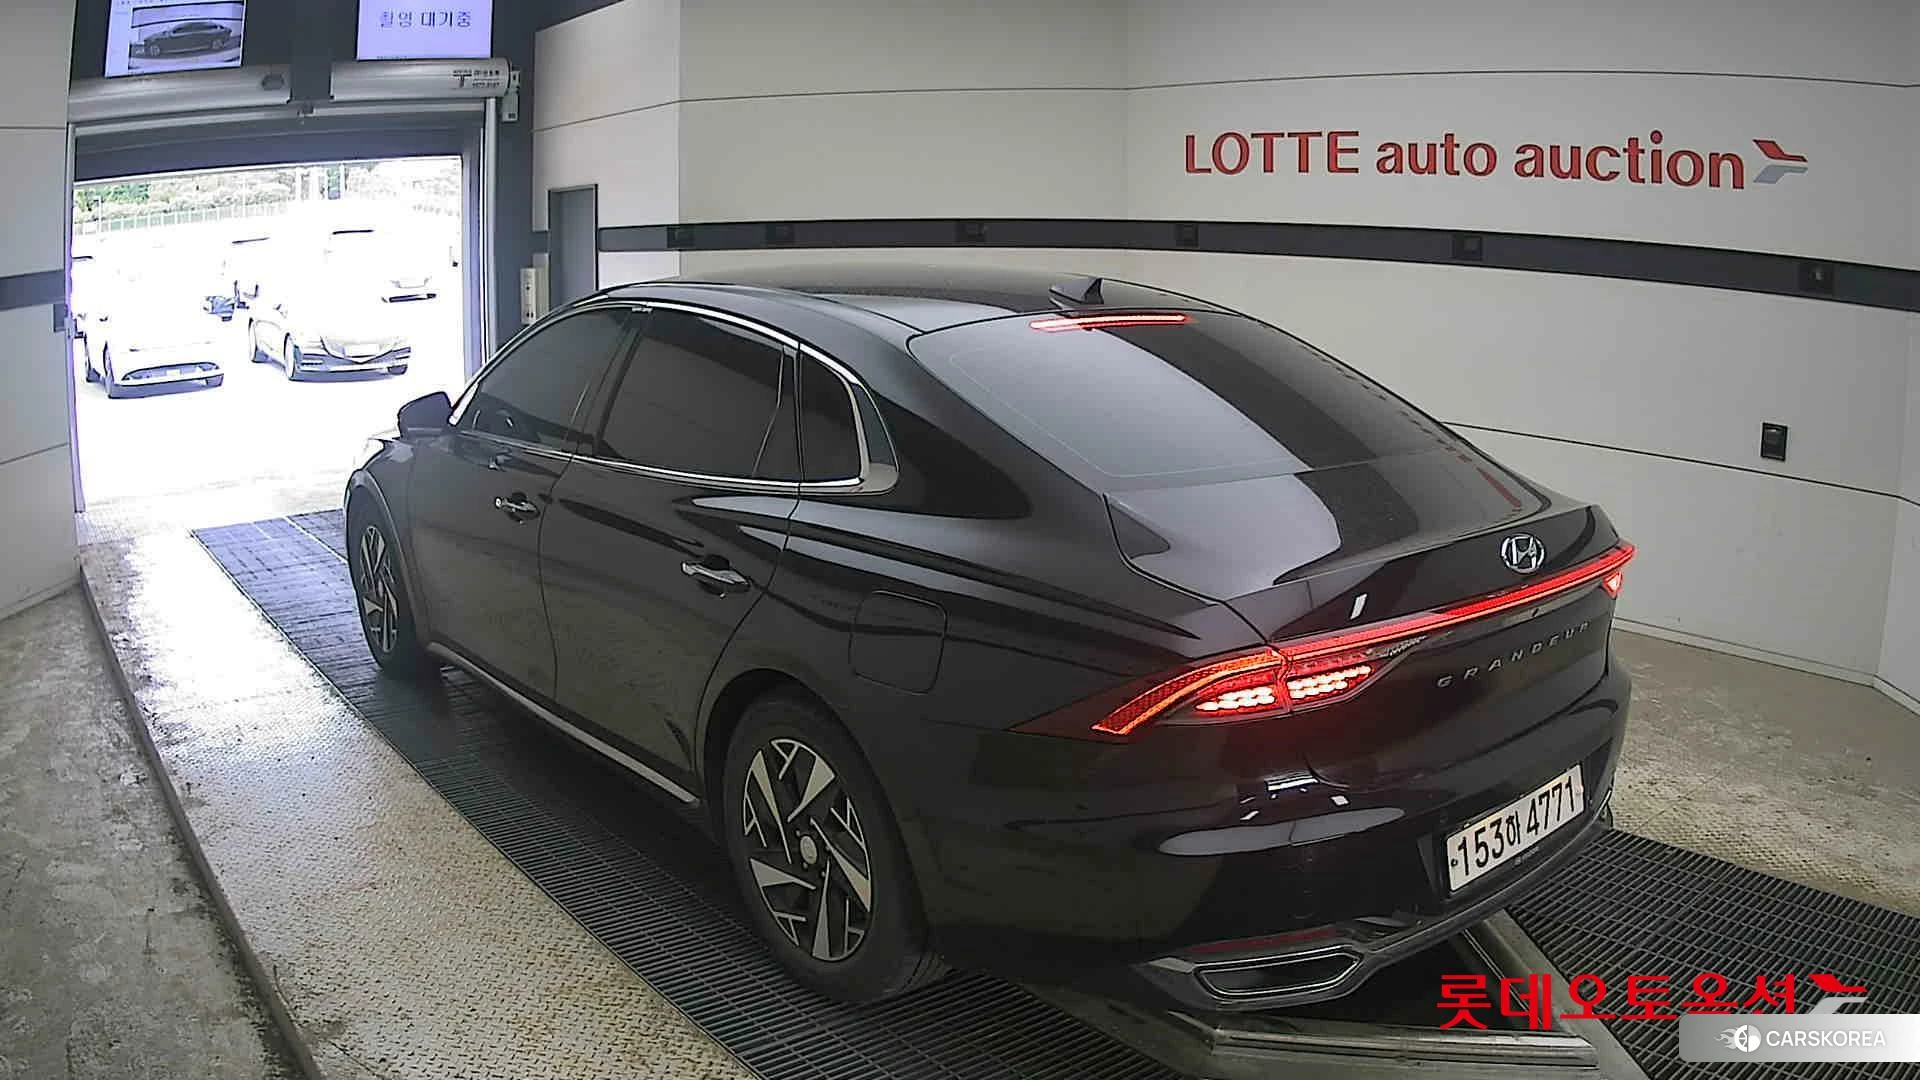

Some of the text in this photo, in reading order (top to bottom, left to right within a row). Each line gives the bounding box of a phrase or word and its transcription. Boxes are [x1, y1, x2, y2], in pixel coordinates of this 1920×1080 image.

[420, 11, 471, 28] 대기중
[1185, 130, 1746, 190] LOTTE auto auction
[1436, 620, 1590, 688] GRANDEUR
[1526, 775, 1575, 836] 4771
